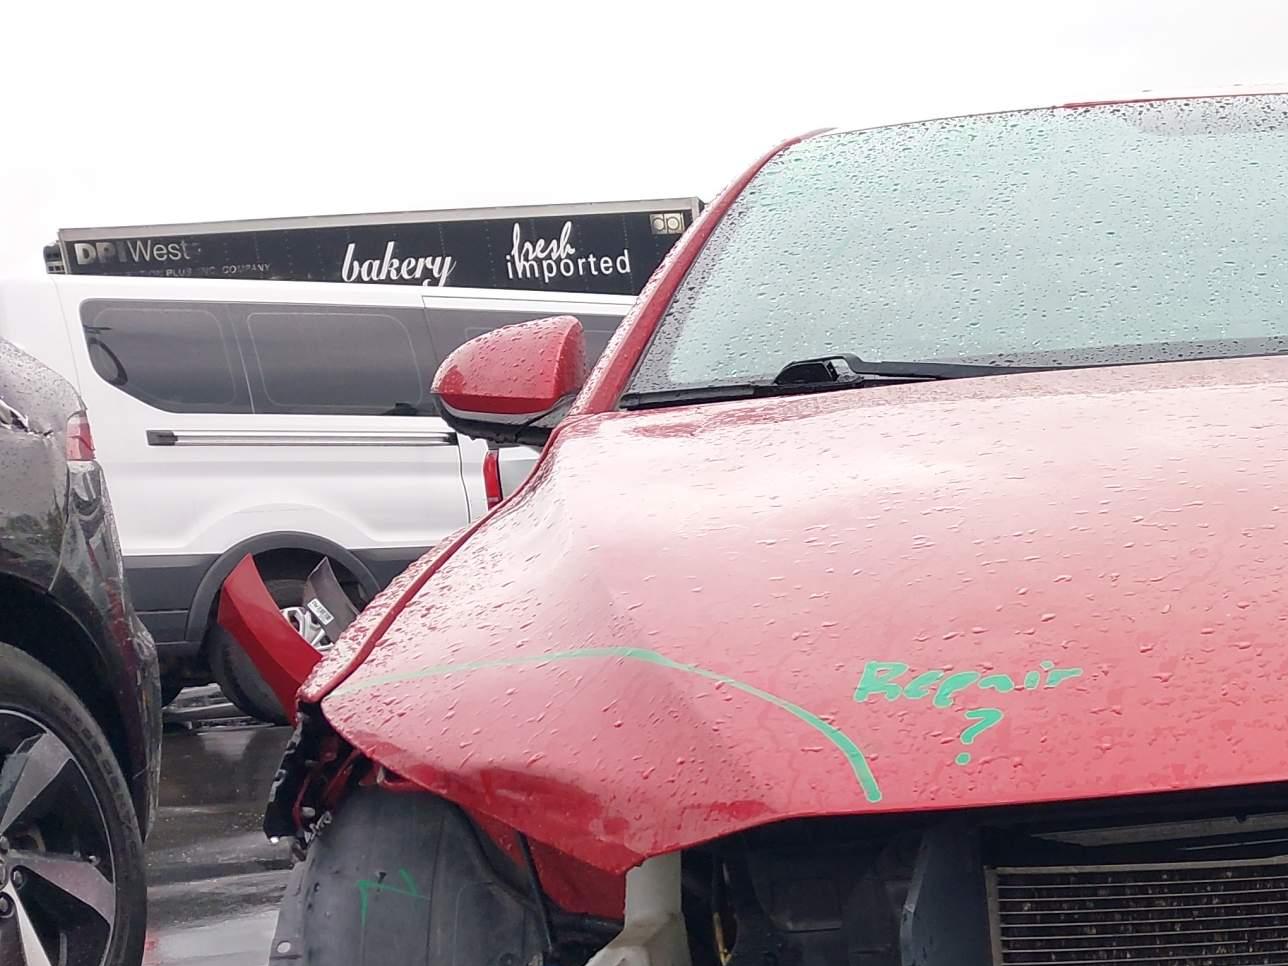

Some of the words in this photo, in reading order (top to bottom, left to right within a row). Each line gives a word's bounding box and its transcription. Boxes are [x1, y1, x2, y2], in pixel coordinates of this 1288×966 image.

[127, 240, 192, 262] West
[341, 240, 457, 288] bakery
[506, 249, 631, 283] imported
[511, 221, 576, 278] fresh
